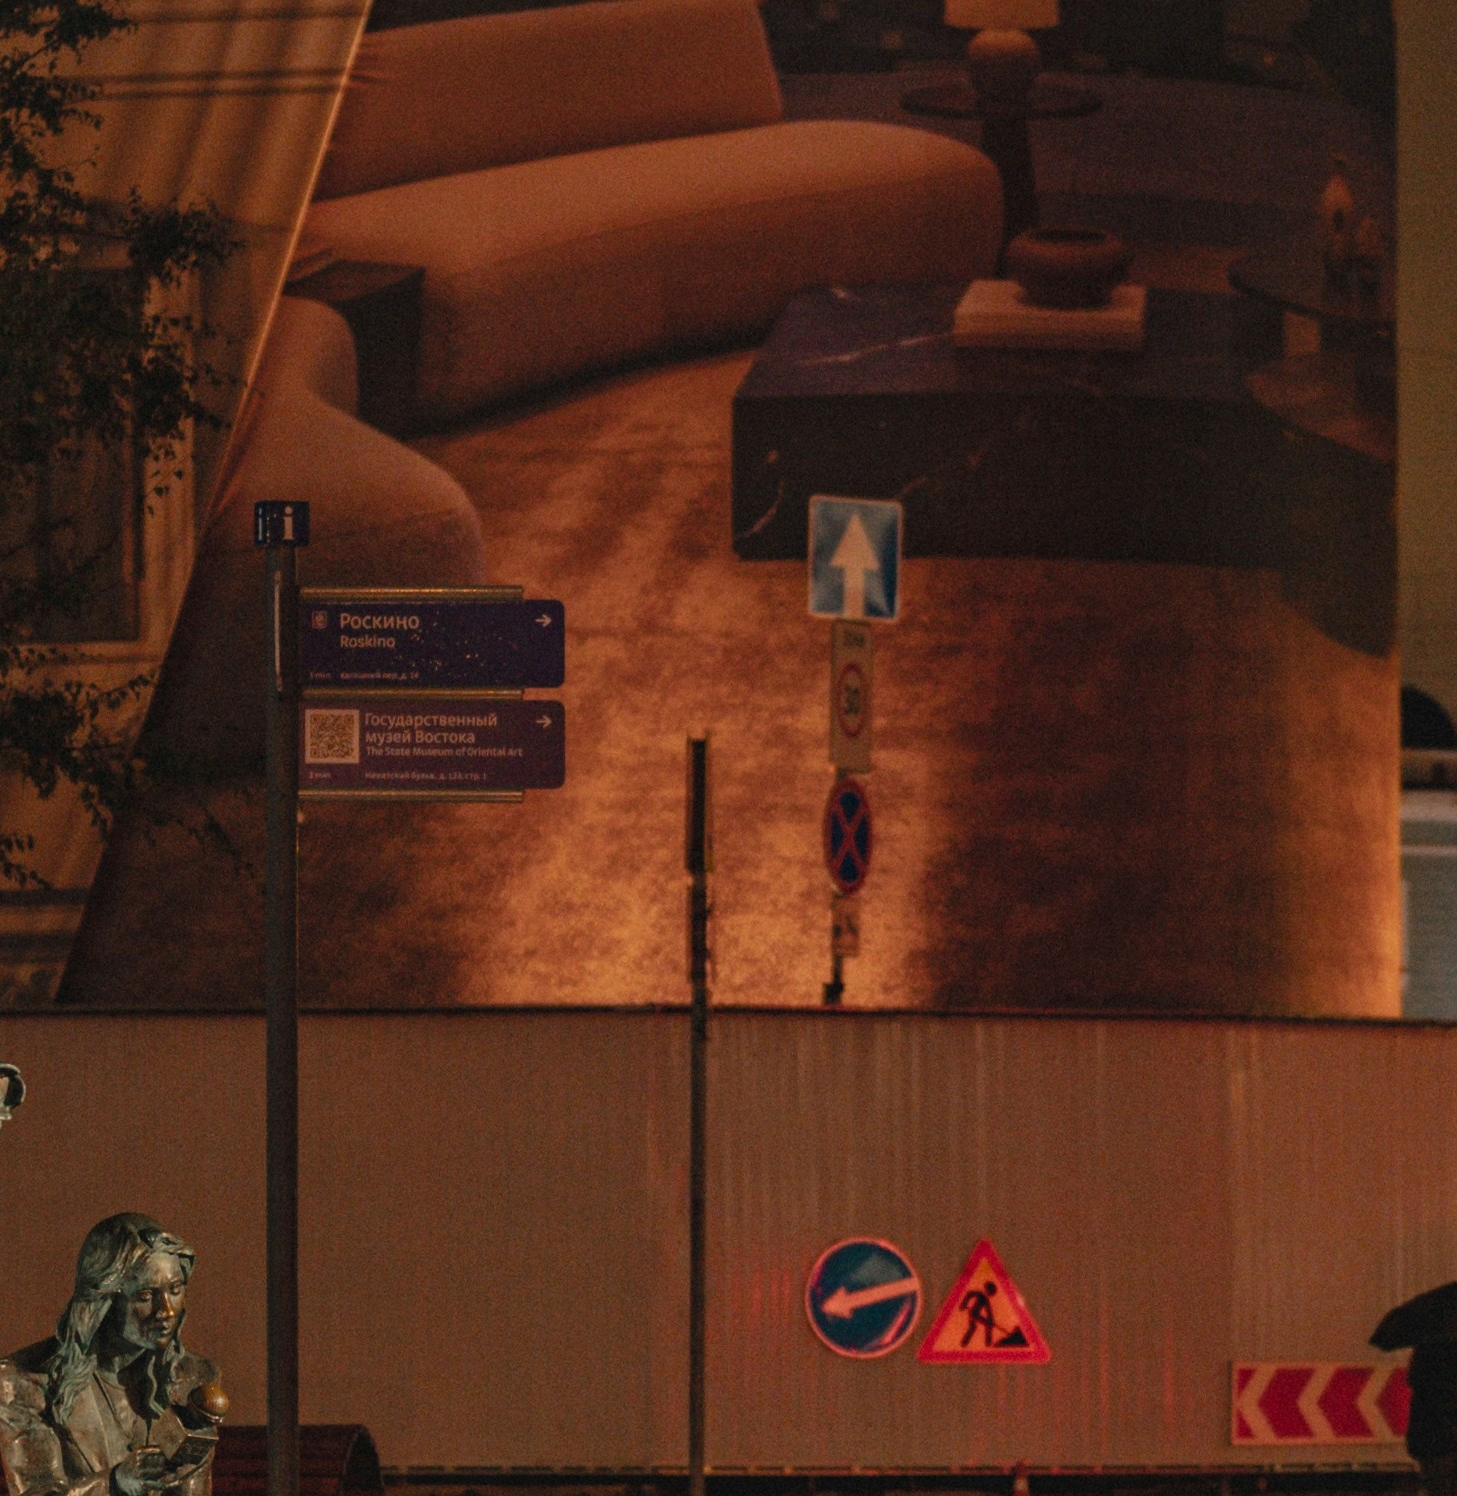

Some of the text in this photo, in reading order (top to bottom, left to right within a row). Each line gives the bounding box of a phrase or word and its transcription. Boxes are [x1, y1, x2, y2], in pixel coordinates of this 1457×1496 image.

[340, 612, 420, 629] Роскино
[340, 634, 396, 648] Roskino
[365, 712, 497, 729] Государственный
[365, 730, 475, 746] музей Востока
[366, 746, 523, 756] The State Museum of Oriental Art
